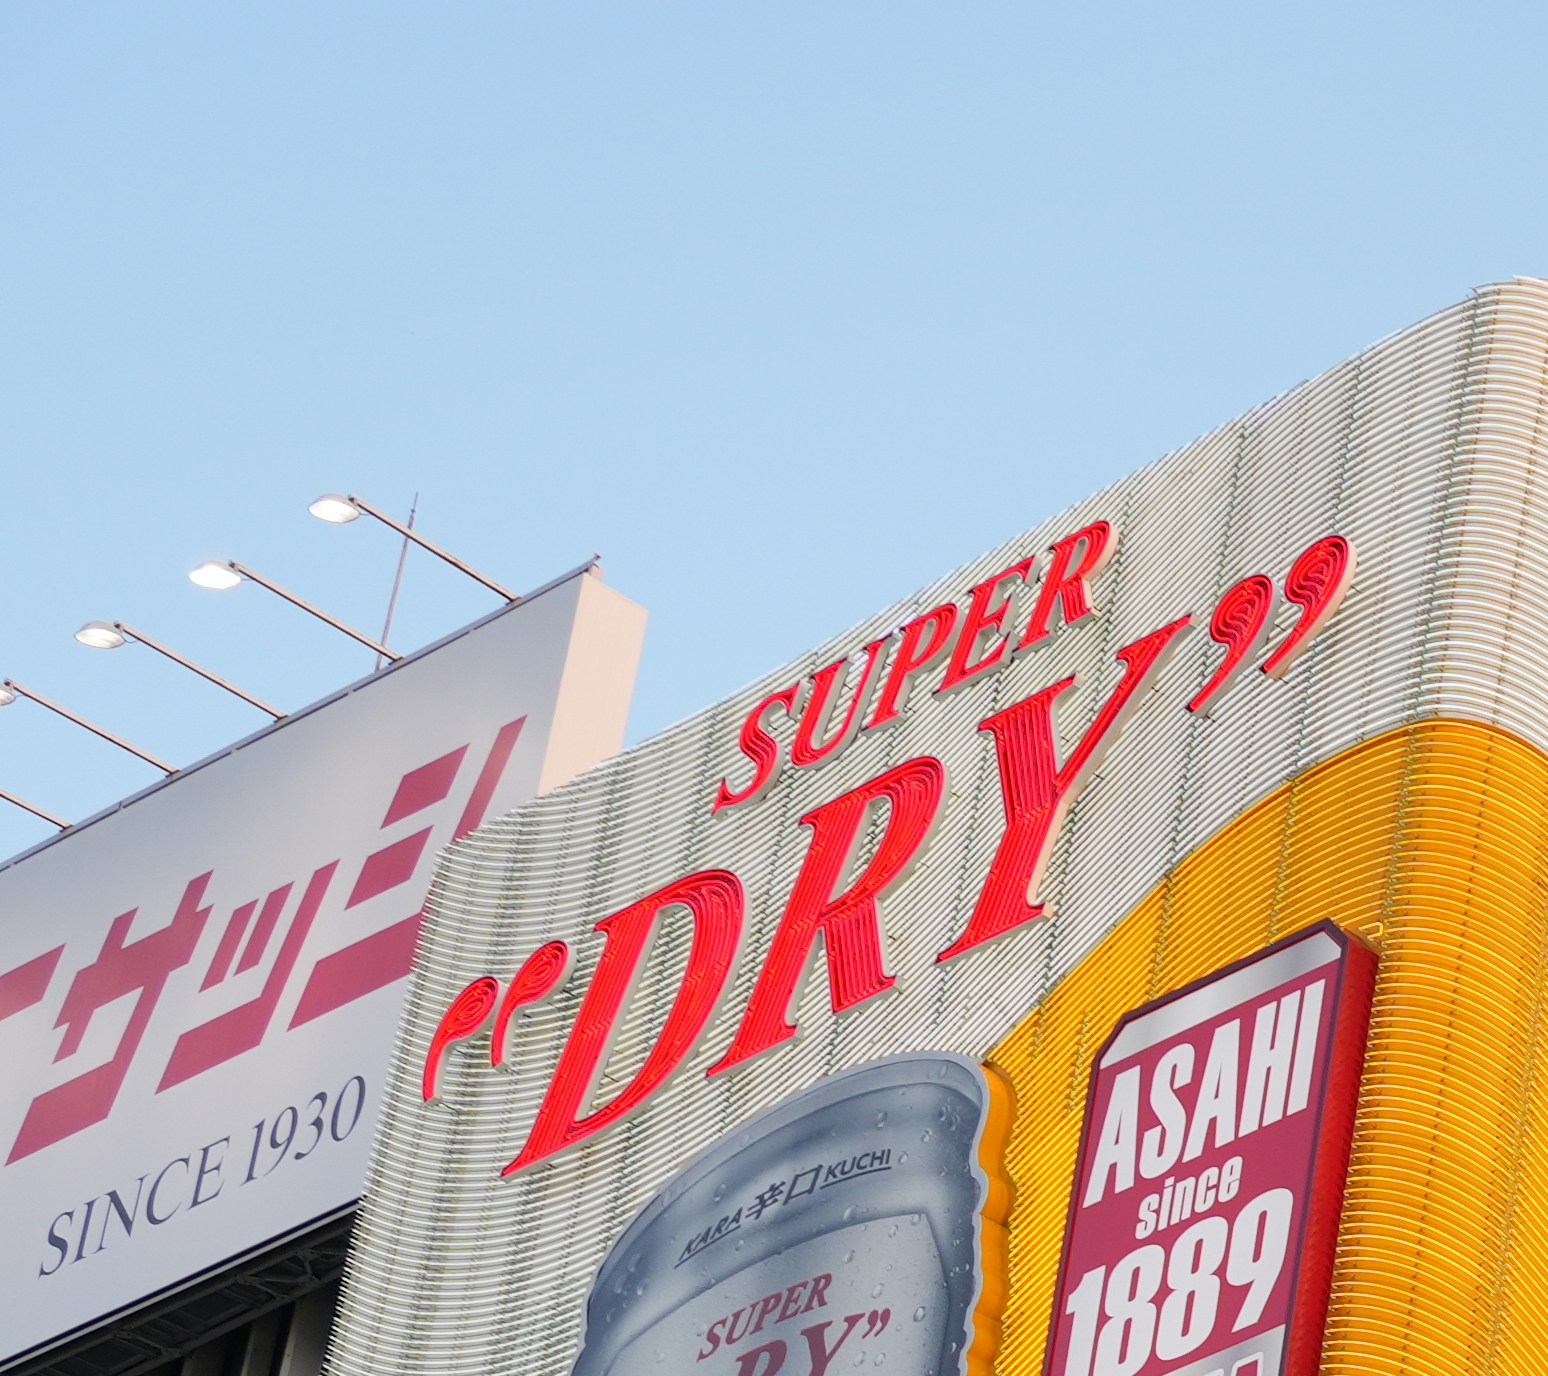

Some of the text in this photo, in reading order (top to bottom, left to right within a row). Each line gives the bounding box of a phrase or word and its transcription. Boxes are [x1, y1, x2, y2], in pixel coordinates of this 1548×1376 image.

[713, 519, 1116, 815] SUPER
[1083, 978, 1329, 1208] ASAHI
[38, 1073, 367, 1281] SINCE 1930
[678, 1149, 891, 1260] KARA 辛口 KUCHI
[1133, 1154, 1242, 1241] since
[697, 1273, 832, 1362] SUPER
